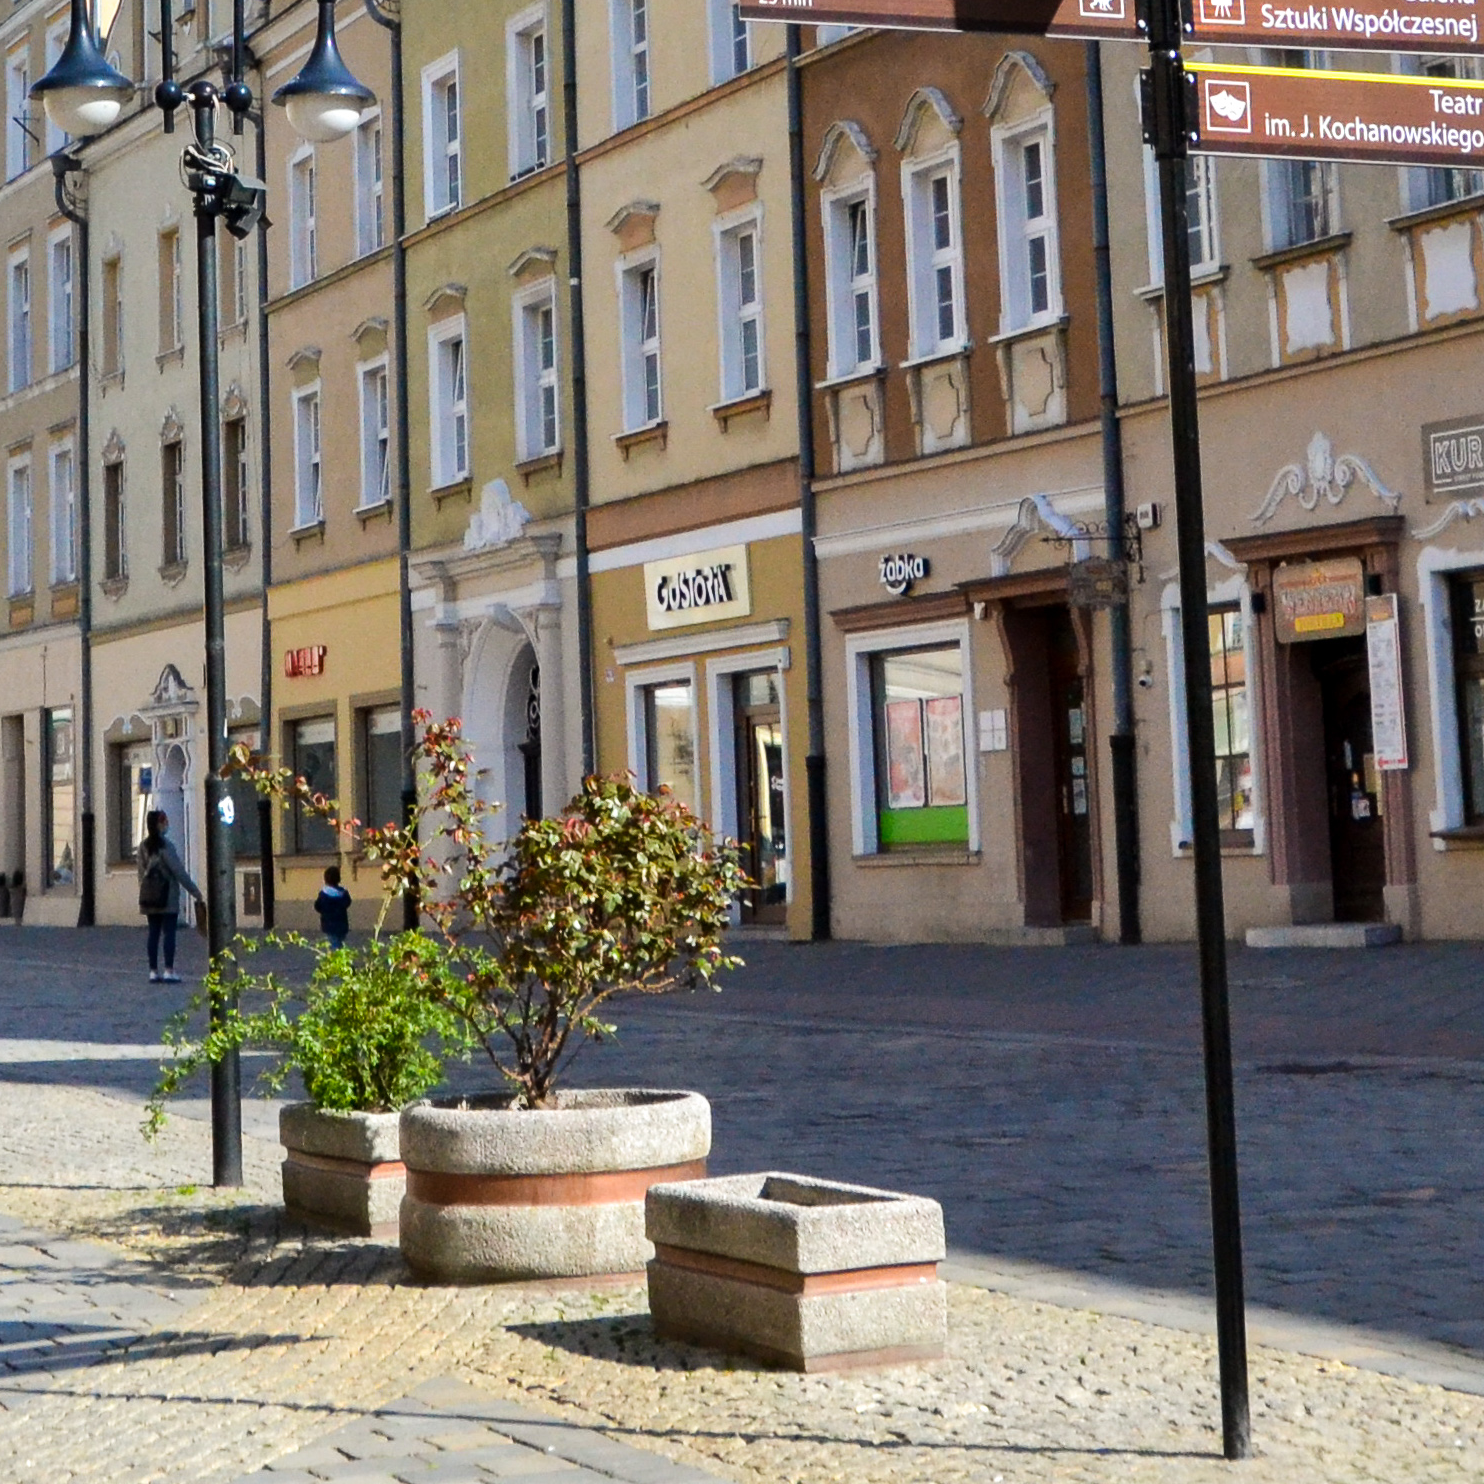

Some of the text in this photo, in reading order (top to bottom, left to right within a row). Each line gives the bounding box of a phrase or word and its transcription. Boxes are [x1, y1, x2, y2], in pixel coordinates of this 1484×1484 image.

[1260, 3, 1479, 42] Sztuki Współczesnej
[1428, 89, 1484, 116] Teatr
[1264, 112, 1484, 153] im. J. Kochanowskiego
[878, 553, 925, 583] żabka
